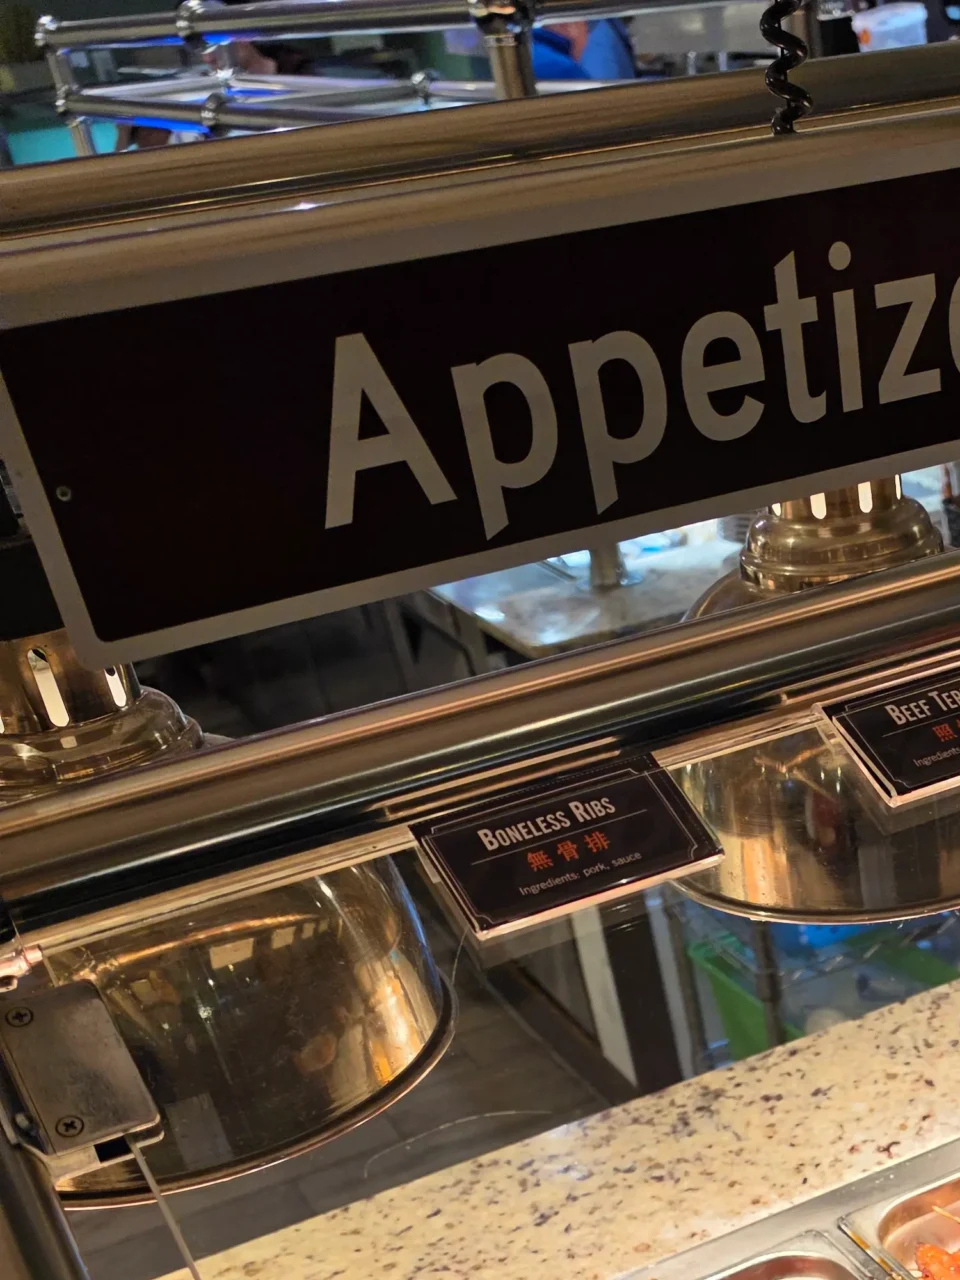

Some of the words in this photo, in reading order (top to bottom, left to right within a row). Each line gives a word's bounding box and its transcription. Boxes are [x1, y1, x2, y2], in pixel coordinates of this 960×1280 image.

[884, 698, 932, 726] BEEF
[476, 809, 571, 852] BONELESS
[568, 796, 616, 824] RIBS
[526, 830, 611, 873] 無骨排
[518, 870, 582, 897] Ingredients:
[582, 863, 611, 879] pork,
[612, 851, 642, 867] sauce
